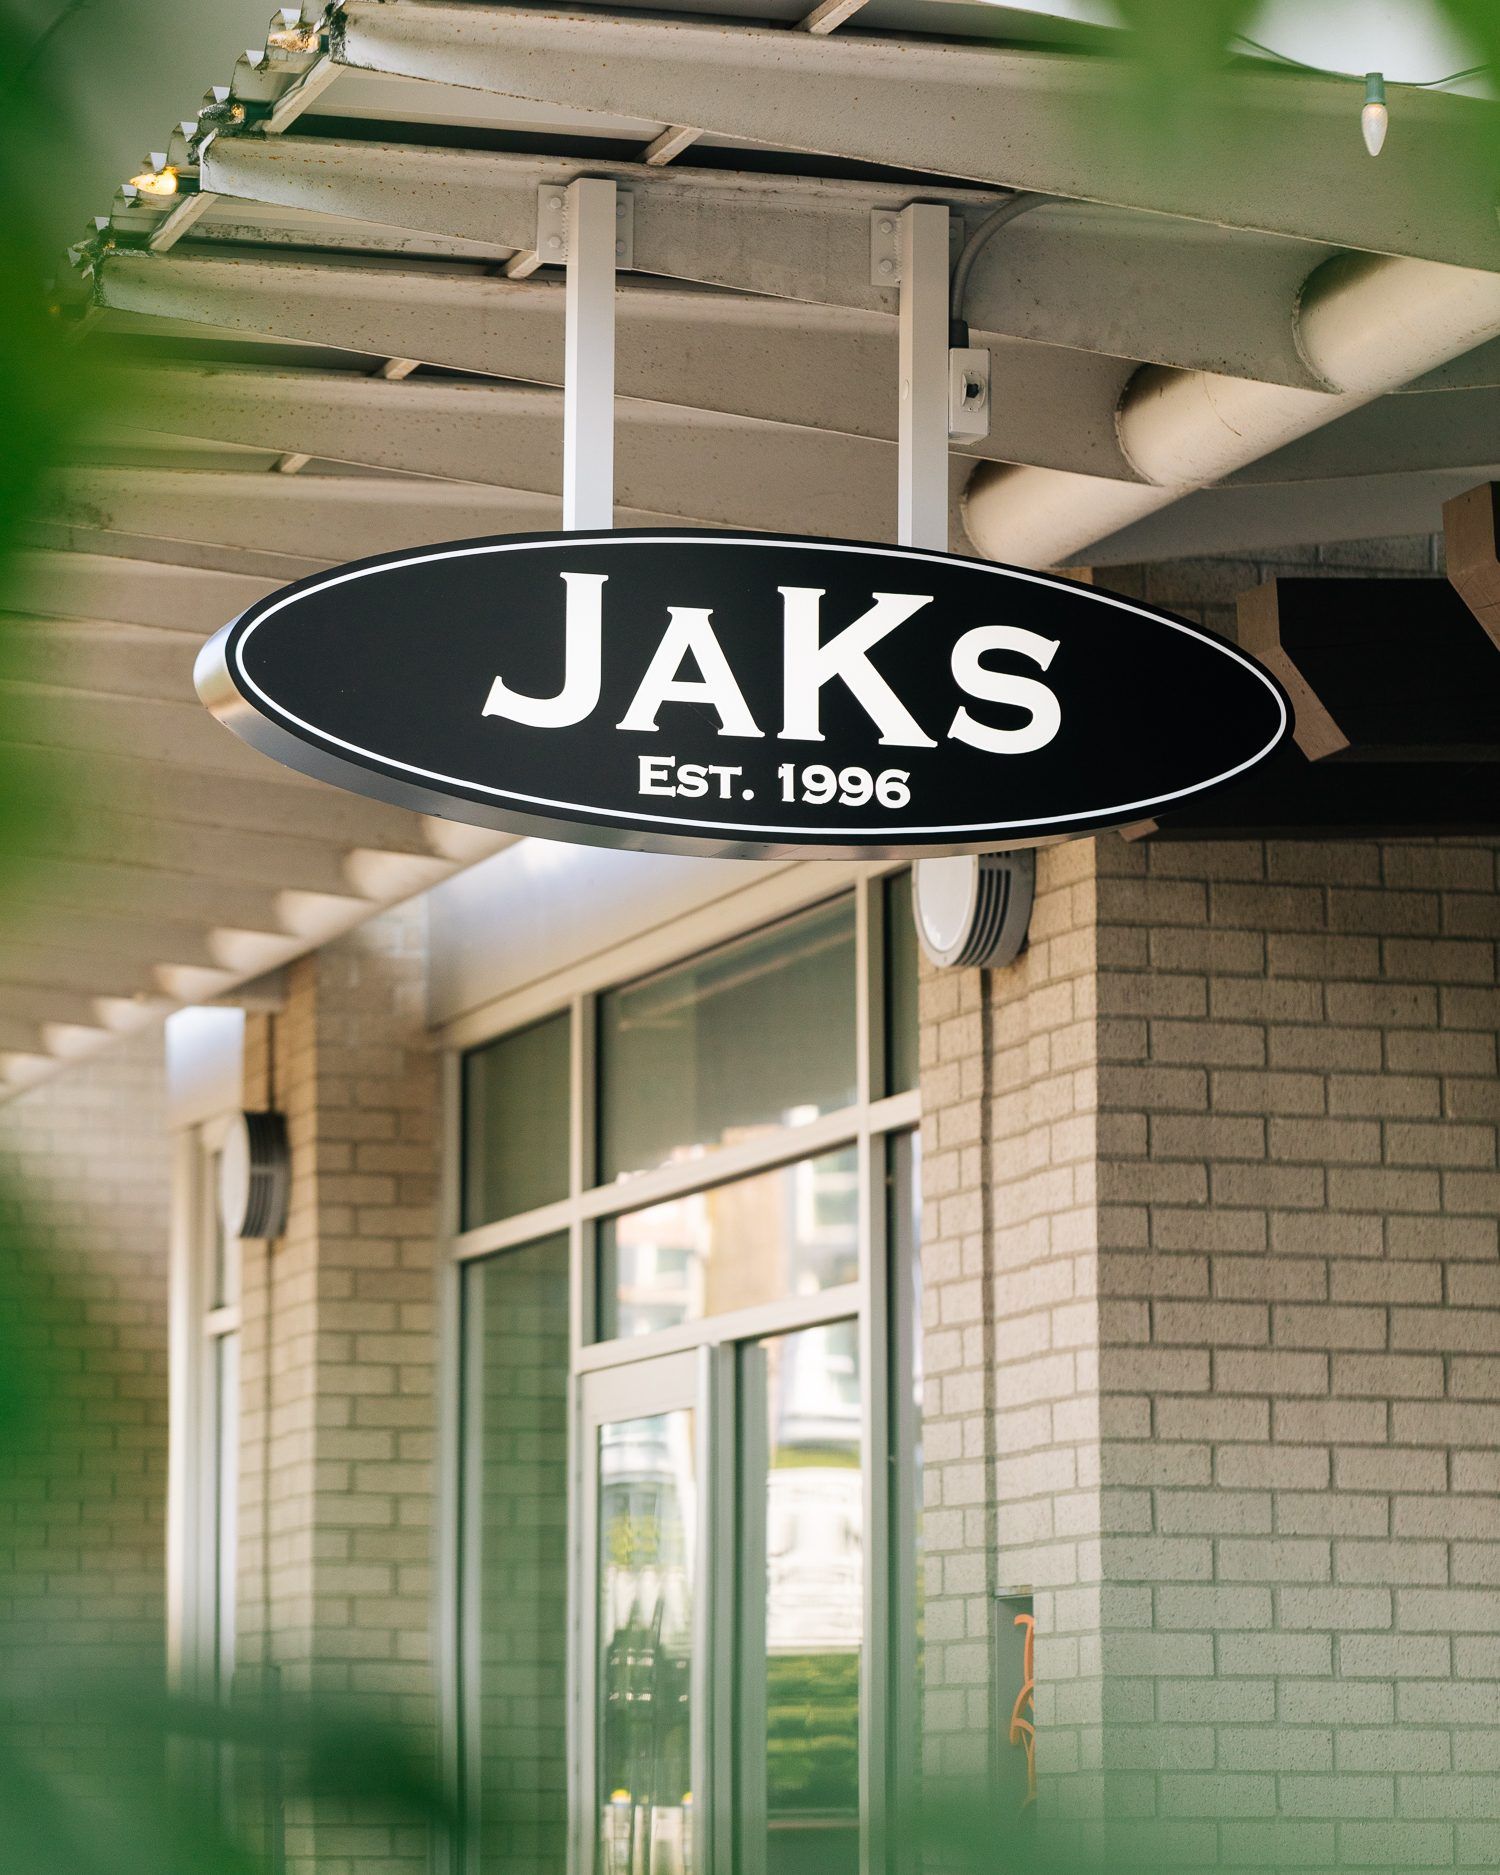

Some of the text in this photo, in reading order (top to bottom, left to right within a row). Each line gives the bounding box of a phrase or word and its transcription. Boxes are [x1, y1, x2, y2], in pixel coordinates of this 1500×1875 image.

[481, 571, 1062, 755] JAKS
[637, 755, 911, 809] EST. 1996
